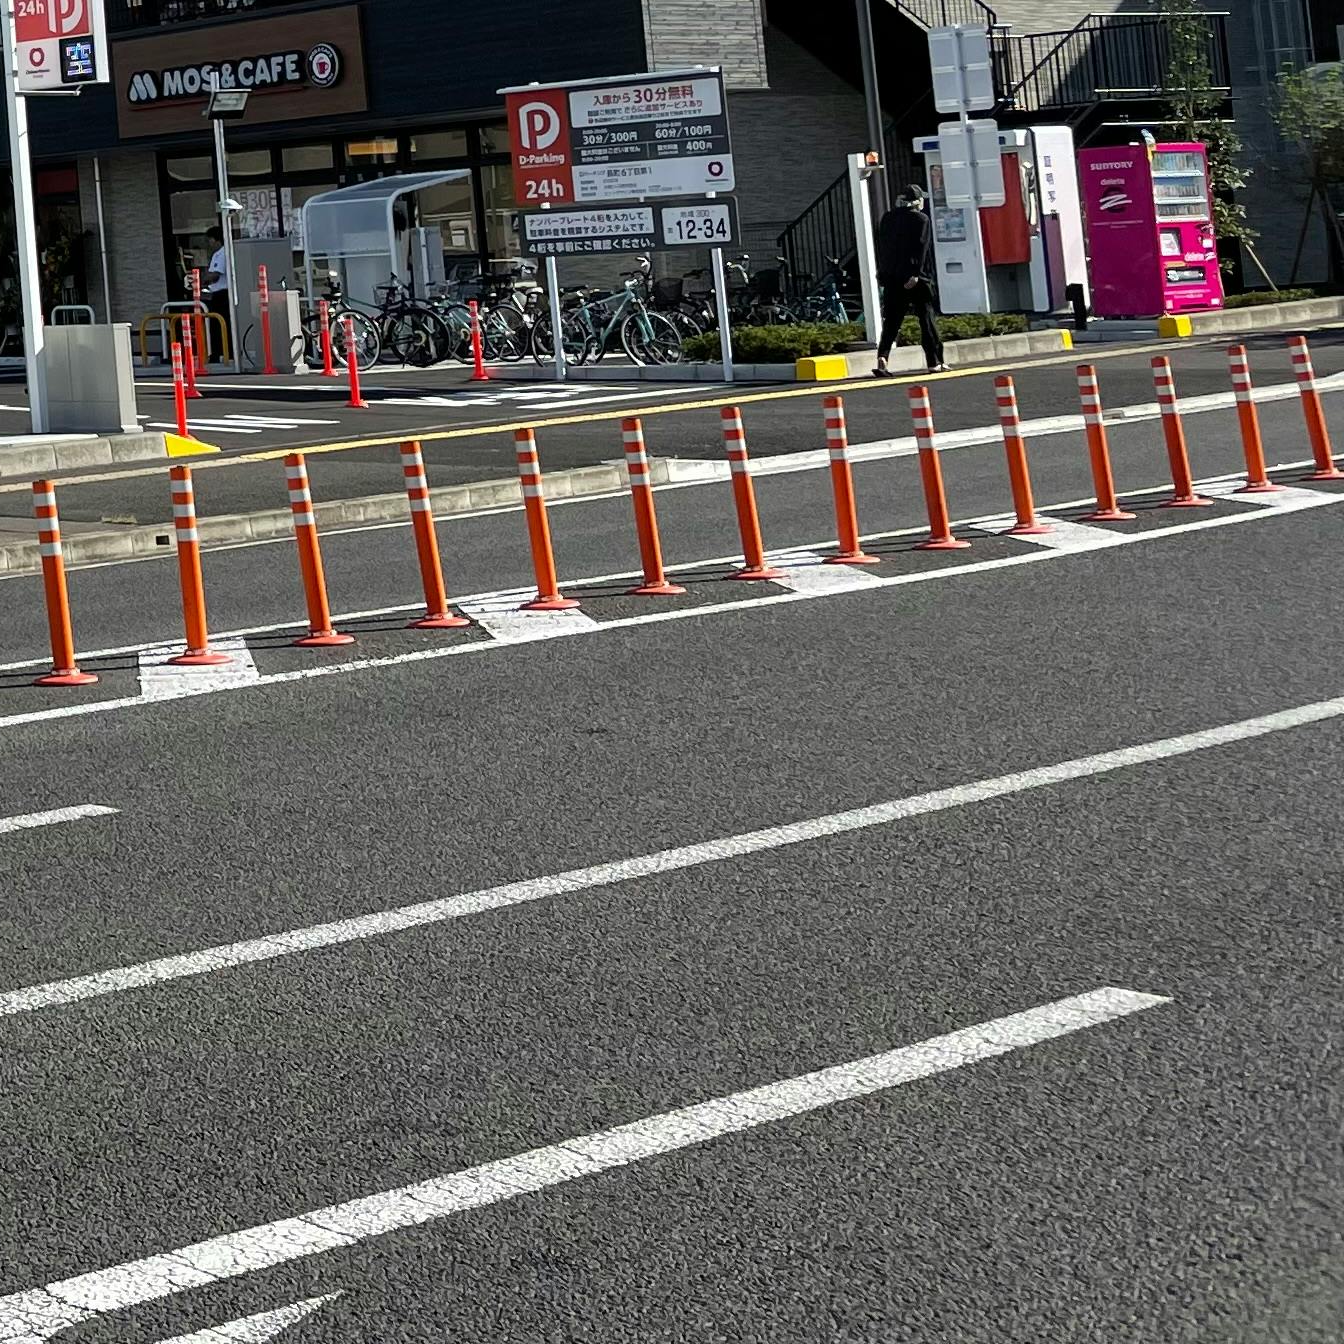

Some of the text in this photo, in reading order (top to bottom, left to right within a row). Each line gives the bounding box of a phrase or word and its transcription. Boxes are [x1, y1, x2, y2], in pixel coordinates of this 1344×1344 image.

[18, 0, 45, 17] 24h
[582, 131, 638, 145] 30分/300円
[655, 125, 712, 139] 60分/100円
[519, 153, 565, 166] D-Parking
[1090, 160, 1134, 171] SUNTORY
[525, 178, 564, 199] 24h
[676, 217, 727, 240] 12-34
